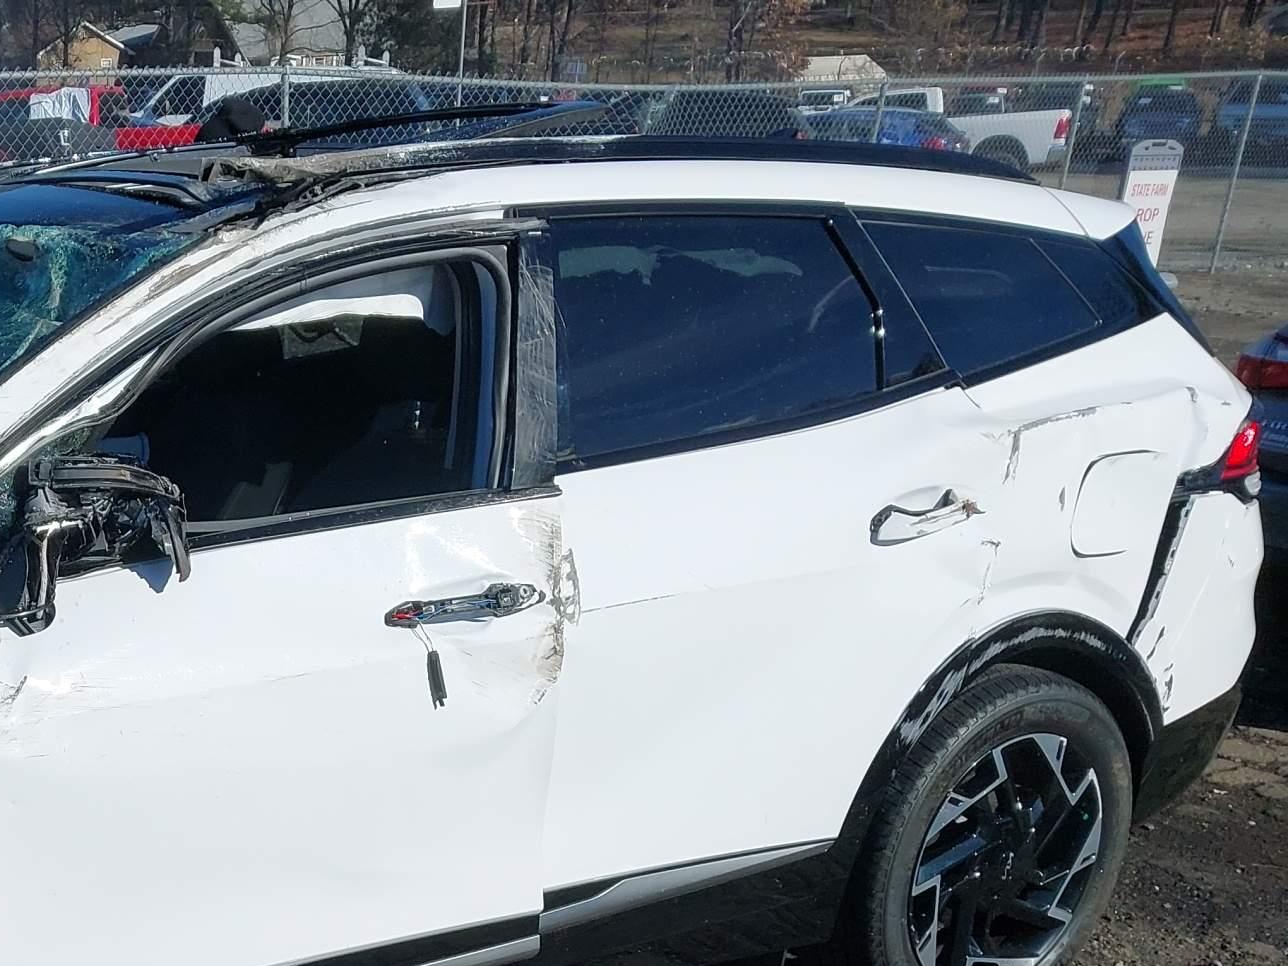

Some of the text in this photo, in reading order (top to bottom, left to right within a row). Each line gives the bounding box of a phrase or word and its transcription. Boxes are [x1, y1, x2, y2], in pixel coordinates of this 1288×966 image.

[1131, 182, 1169, 197] STATE FARM
[1137, 208, 1160, 222] ROP
